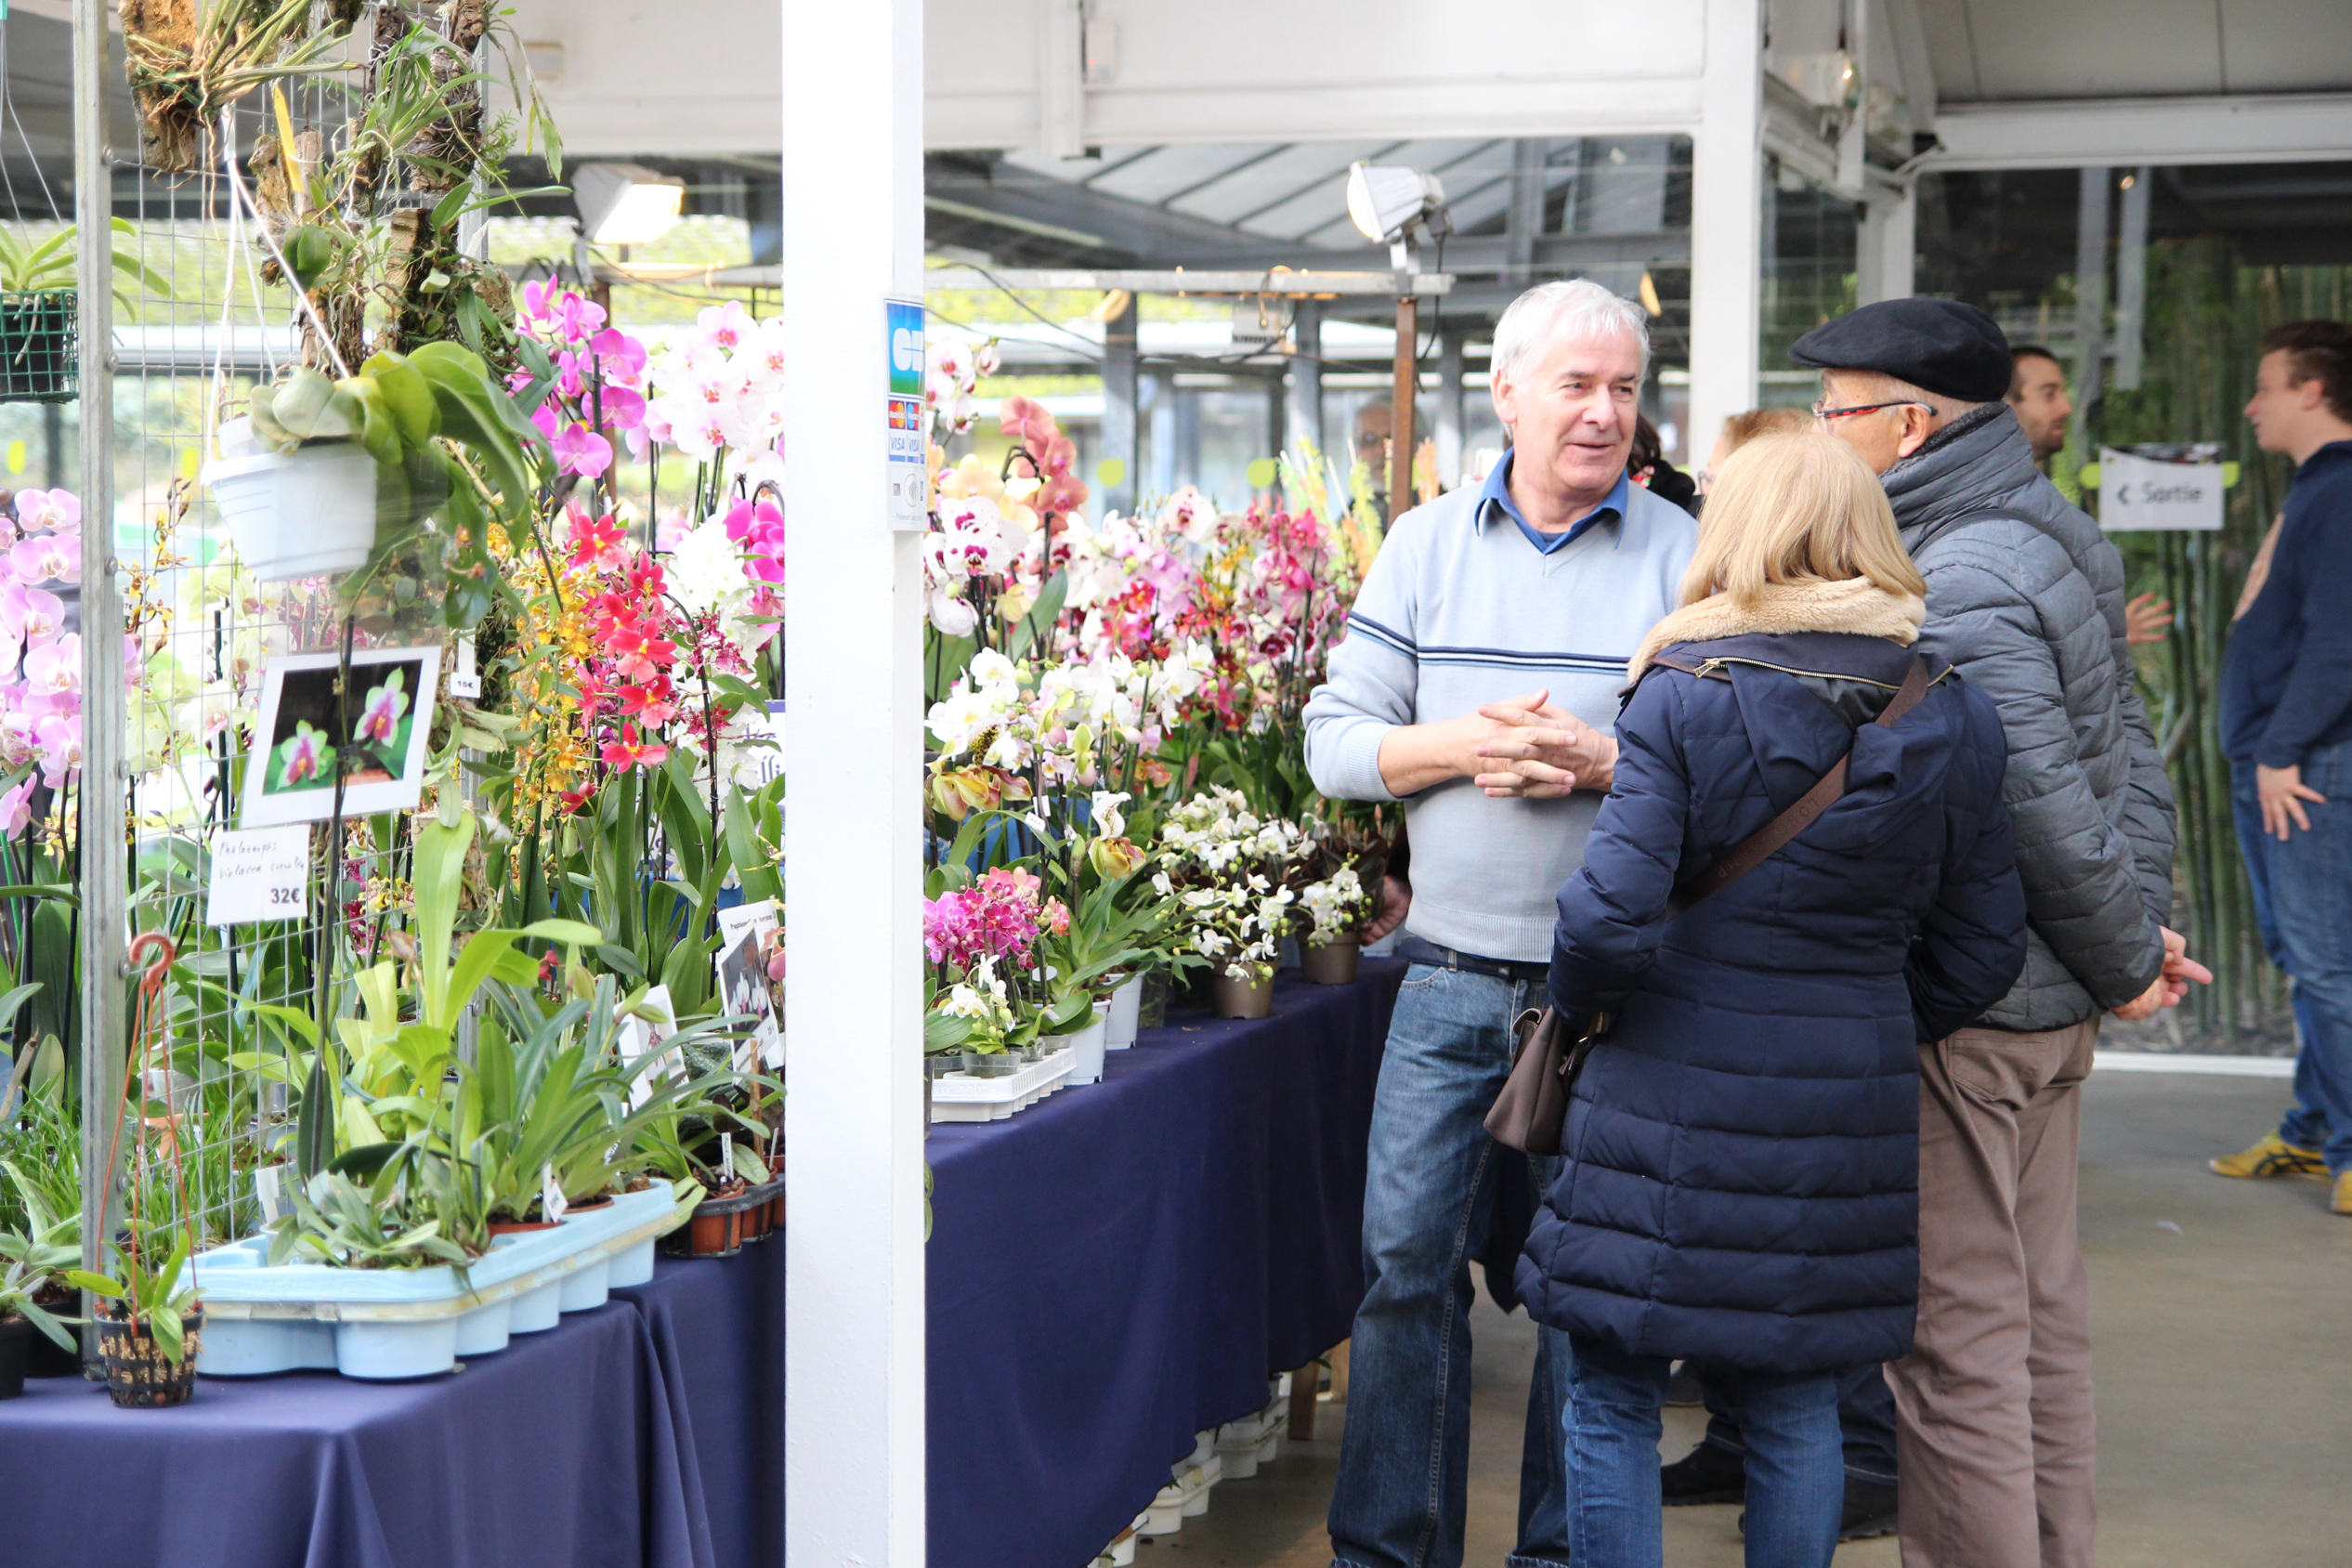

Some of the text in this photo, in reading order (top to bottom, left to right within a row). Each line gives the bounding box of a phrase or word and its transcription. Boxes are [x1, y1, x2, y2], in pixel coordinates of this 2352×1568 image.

[890, 437, 906, 451] VISA
[2142, 480, 2202, 503] Sortie
[270, 887, 300, 905] 32€
